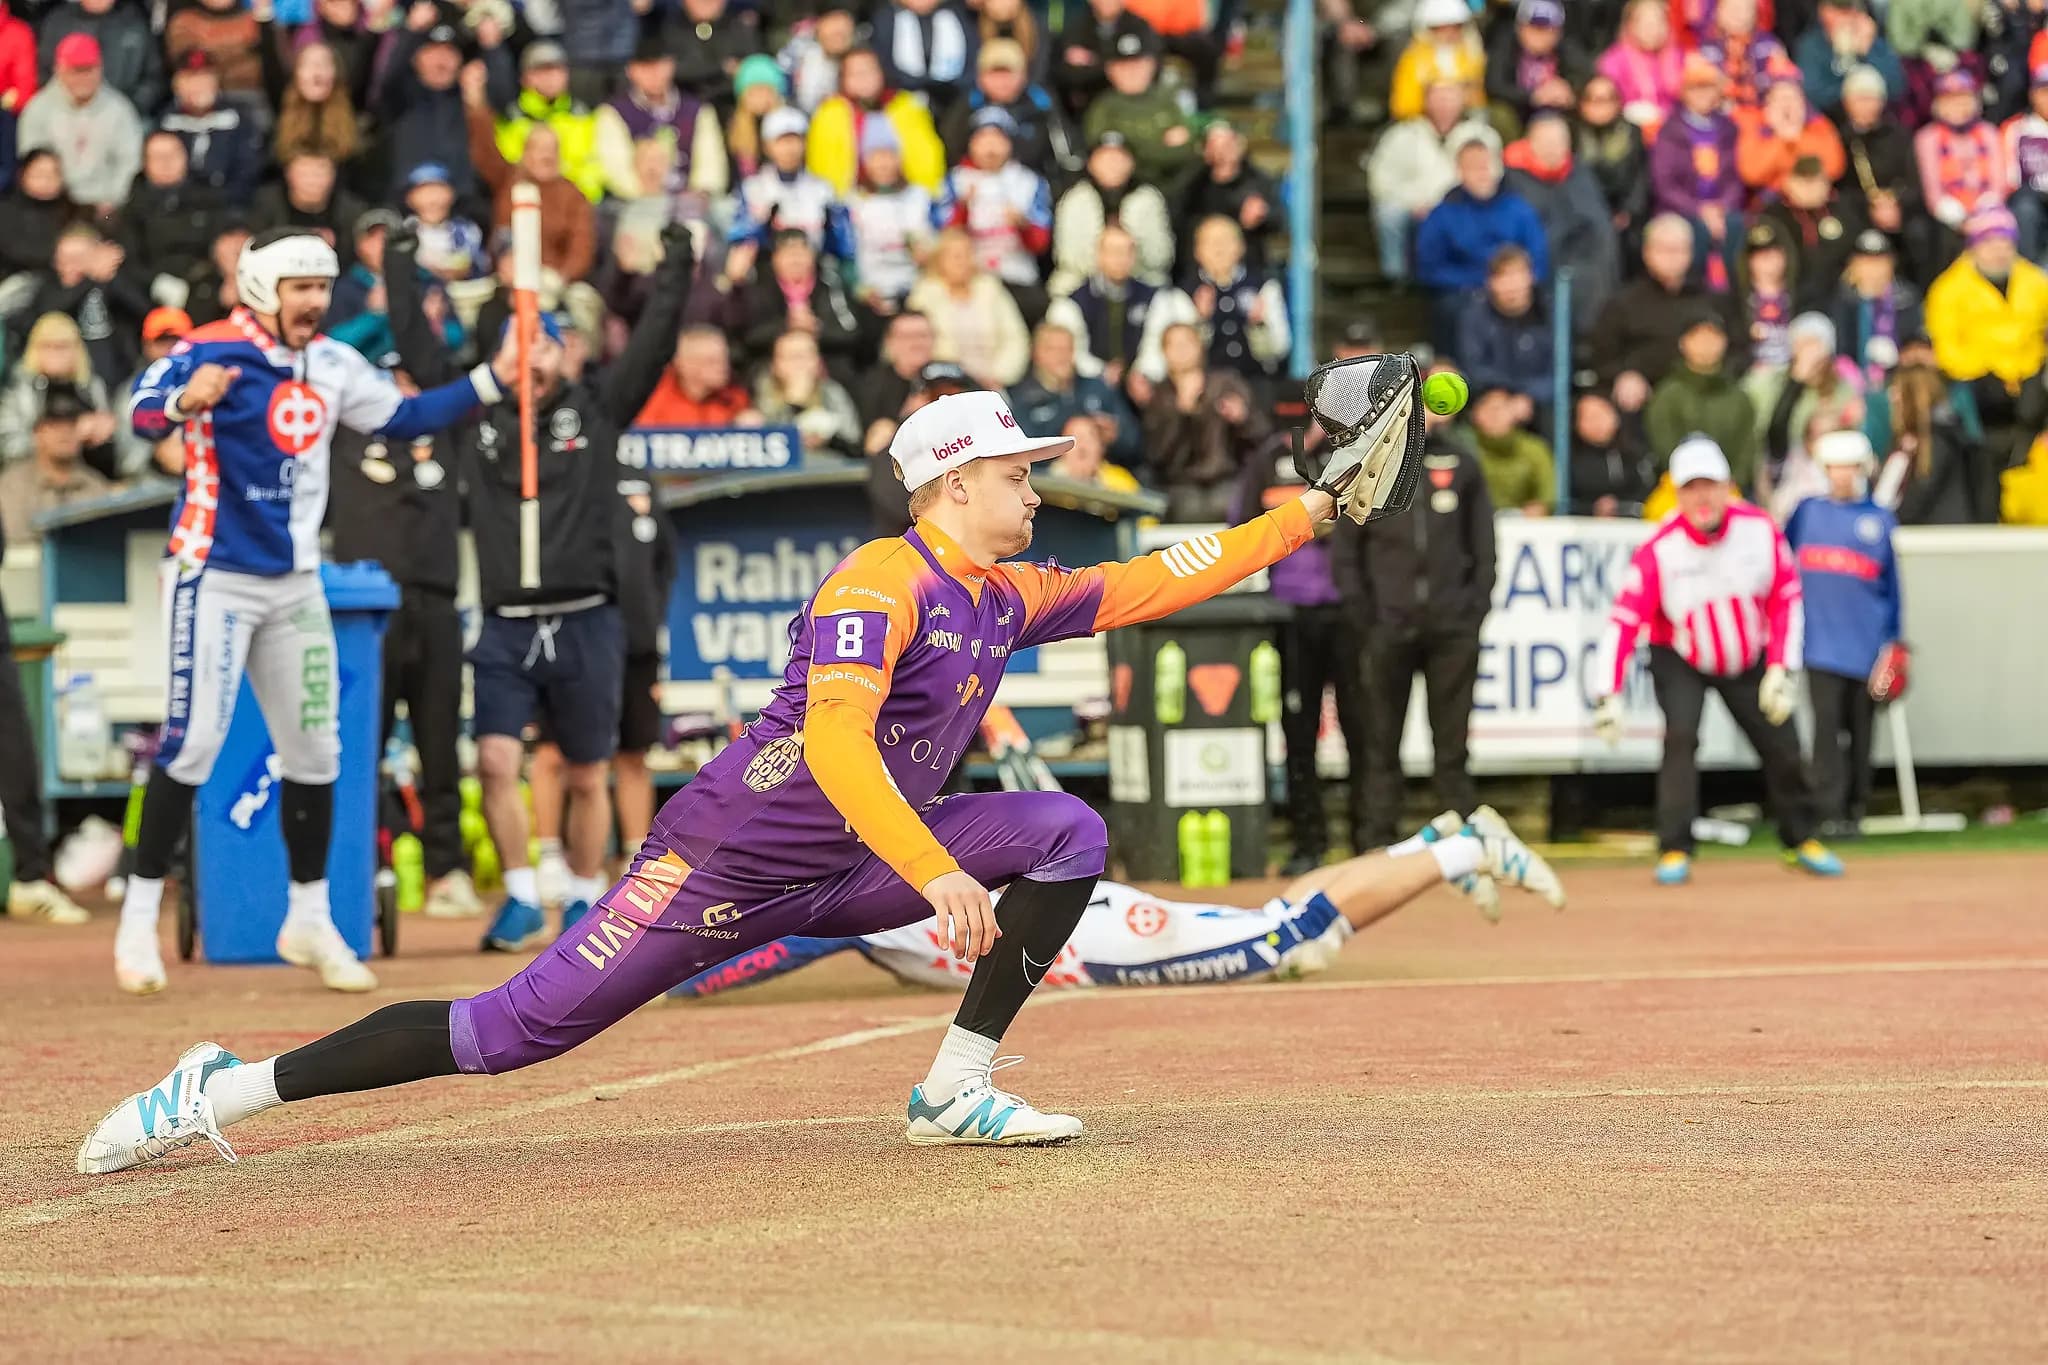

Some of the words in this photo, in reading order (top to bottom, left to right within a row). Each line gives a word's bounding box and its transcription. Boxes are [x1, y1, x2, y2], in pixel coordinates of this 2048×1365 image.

[648, 432, 791, 469] TRAVELS
[932, 435, 974, 461] loiste
[850, 587, 897, 608] catalyst
[835, 616, 864, 658] 8
[301, 645, 330, 734] EEPEE
